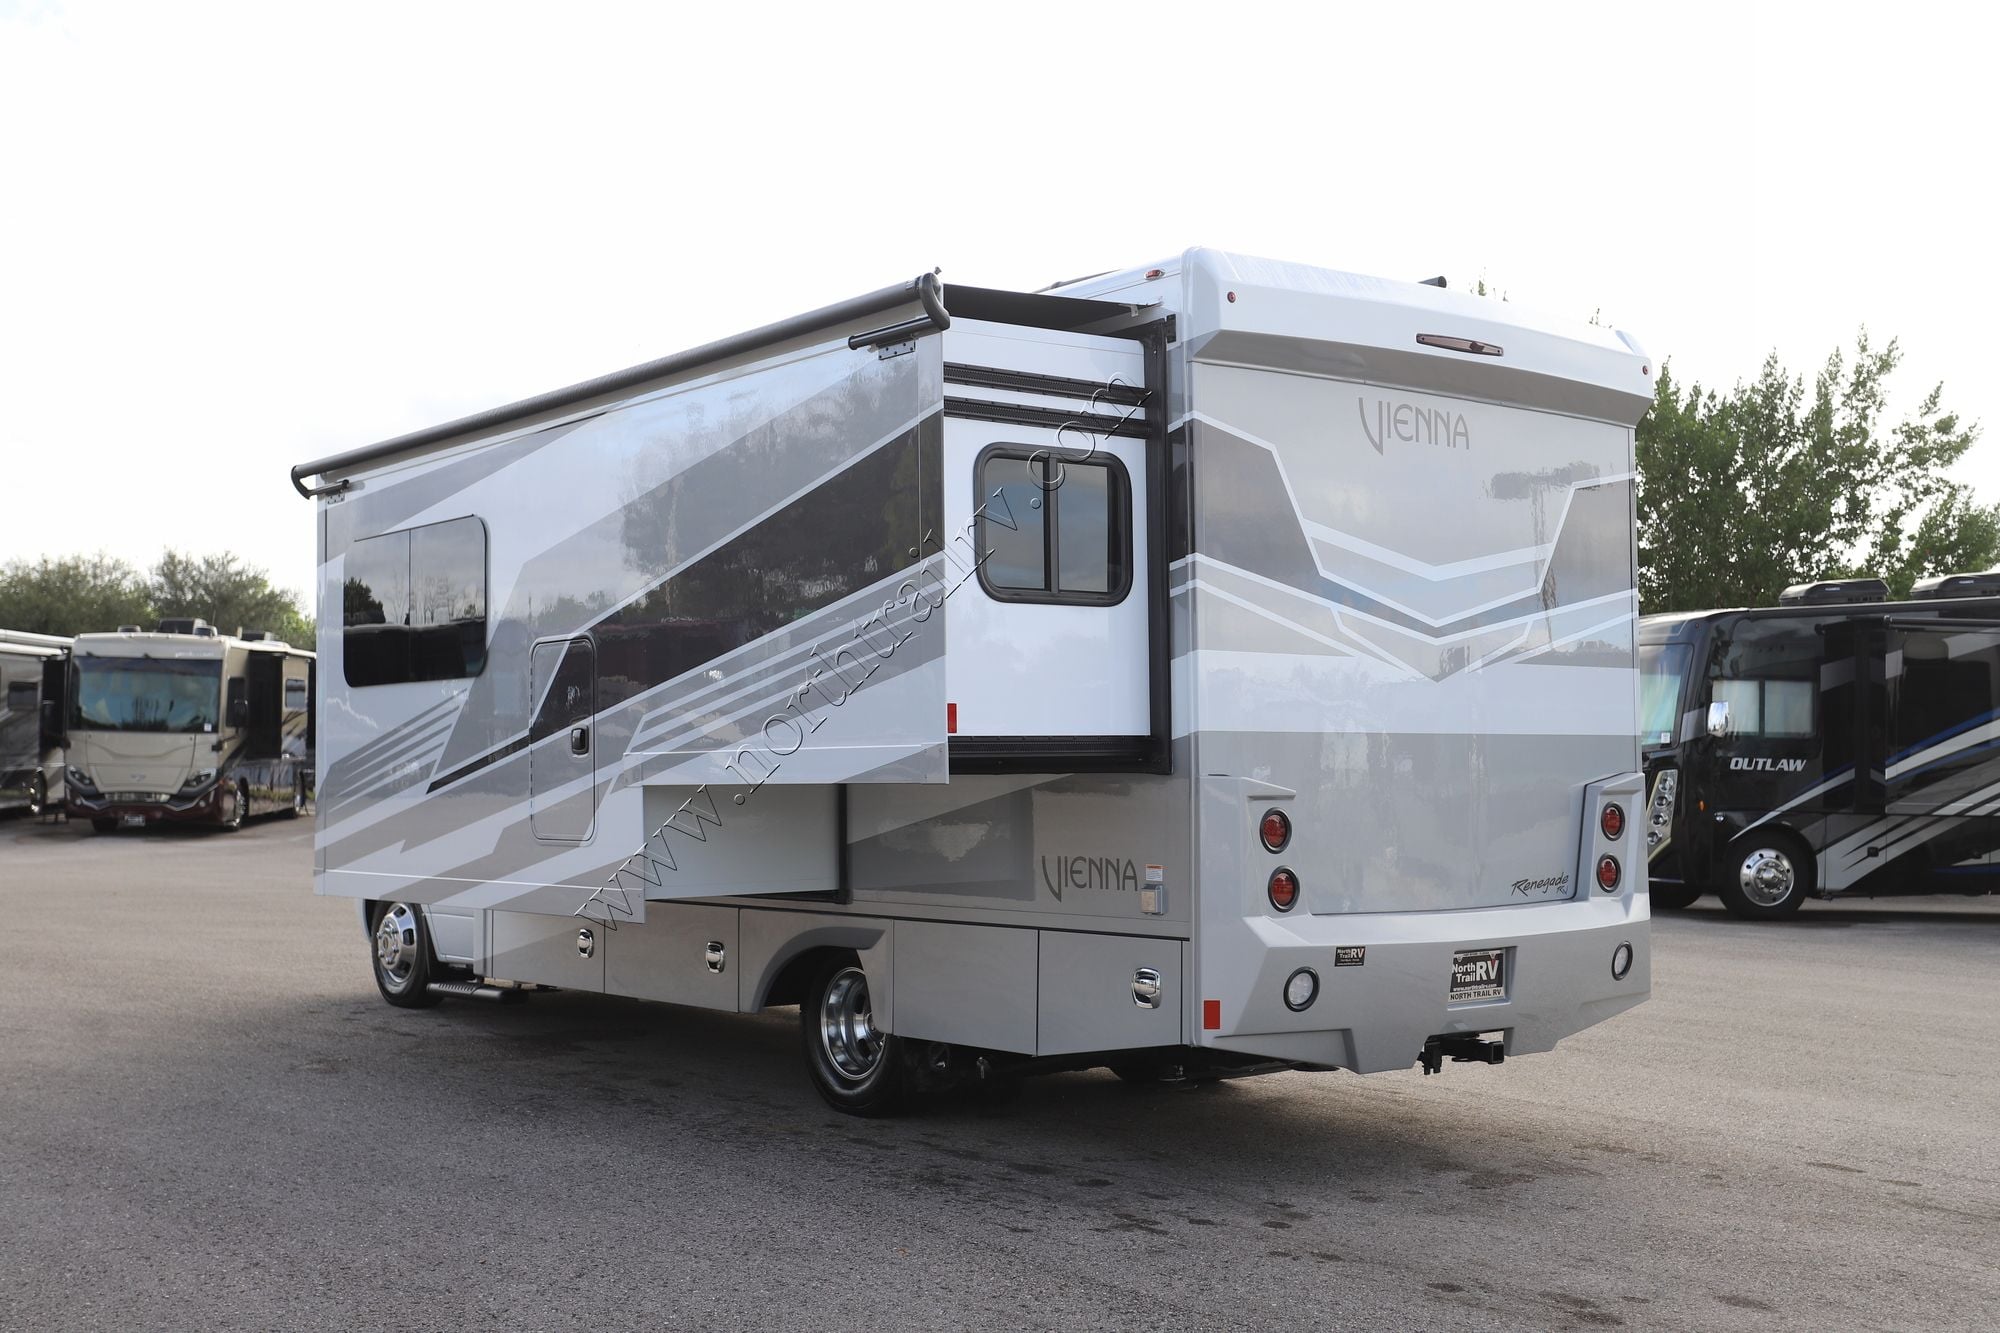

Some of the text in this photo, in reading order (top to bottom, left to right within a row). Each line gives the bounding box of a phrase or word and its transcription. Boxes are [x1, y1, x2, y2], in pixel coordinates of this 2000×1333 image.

[1358, 397, 1469, 456] VIENNA
[1729, 757, 1807, 771] OUTLAW
[1041, 855, 1138, 902] VIENNA
[1511, 872, 1569, 897] Renegade
[1350, 948, 1364, 958] RV
[1452, 962, 1476, 973] North
[1476, 960, 1500, 981] RV
[1456, 972, 1475, 983] Trail
[1450, 988, 1502, 1001] NORTH TRAIL RV
